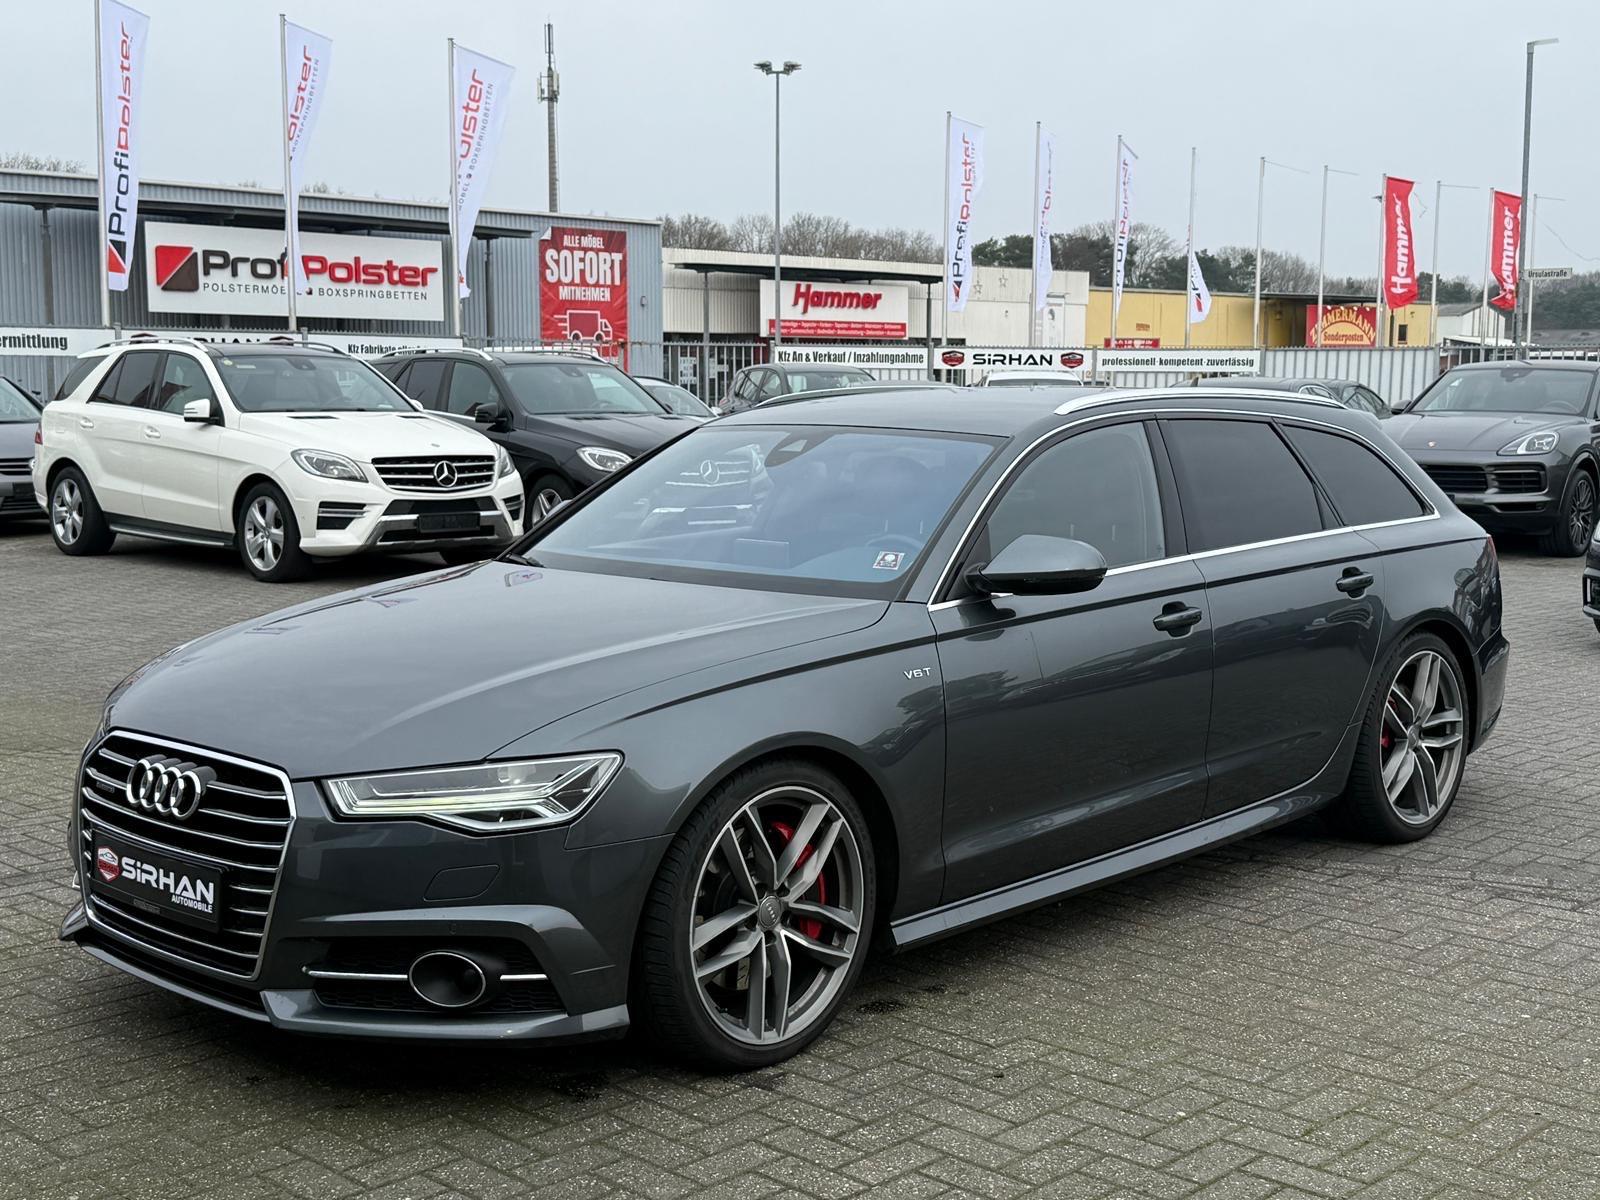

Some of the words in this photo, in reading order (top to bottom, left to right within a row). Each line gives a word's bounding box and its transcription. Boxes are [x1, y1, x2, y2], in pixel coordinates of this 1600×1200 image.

[108, 20, 132, 236] ProfiPolster
[563, 235, 580, 247] ALLE
[580, 234, 604, 249] MÖBEL
[1390, 193, 1412, 294] Hammer
[202, 246, 438, 287] ProfPolster
[545, 248, 623, 286] SOFORT
[1528, 269, 1568, 278] Ursulastraße
[318, 287, 428, 300] BOXSPRINGBETTEN
[559, 286, 611, 302] MITNEHMEN
[792, 283, 882, 315] Hammer
[1323, 331, 1364, 344] Sonderposten
[347, 344, 360, 354] Kfz
[778, 352, 791, 363] Kfz
[792, 352, 803, 363] An
[804, 353, 811, 362] &
[812, 352, 846, 363] Verkauf
[847, 352, 852, 363] /
[853, 352, 924, 365] Inzahlungnahme
[903, 667, 931, 680] V6T
[171, 894, 213, 914] AUTOMOBILE
